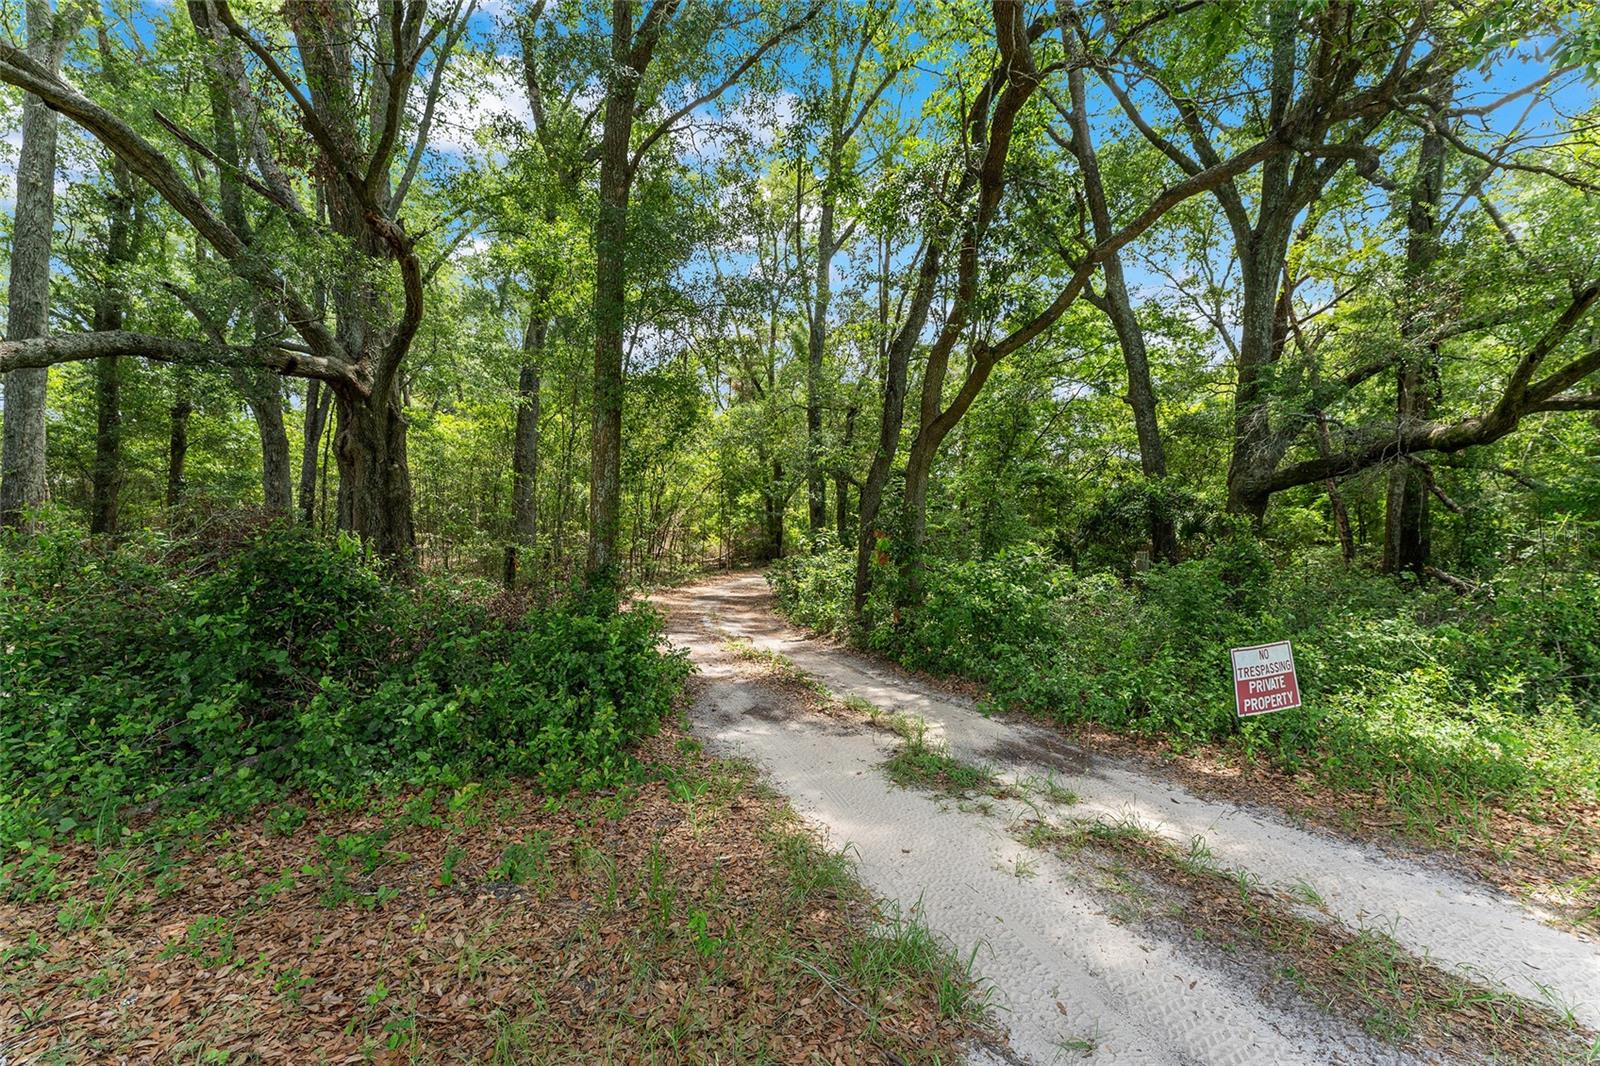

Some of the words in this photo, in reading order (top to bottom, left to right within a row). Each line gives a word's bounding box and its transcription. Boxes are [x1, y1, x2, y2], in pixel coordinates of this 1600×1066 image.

[1258, 648, 1269, 660] NO
[1237, 660, 1291, 679] TRESPASSING
[1248, 675, 1286, 694] PRIVATE
[1244, 691, 1293, 712] PROPERTY
